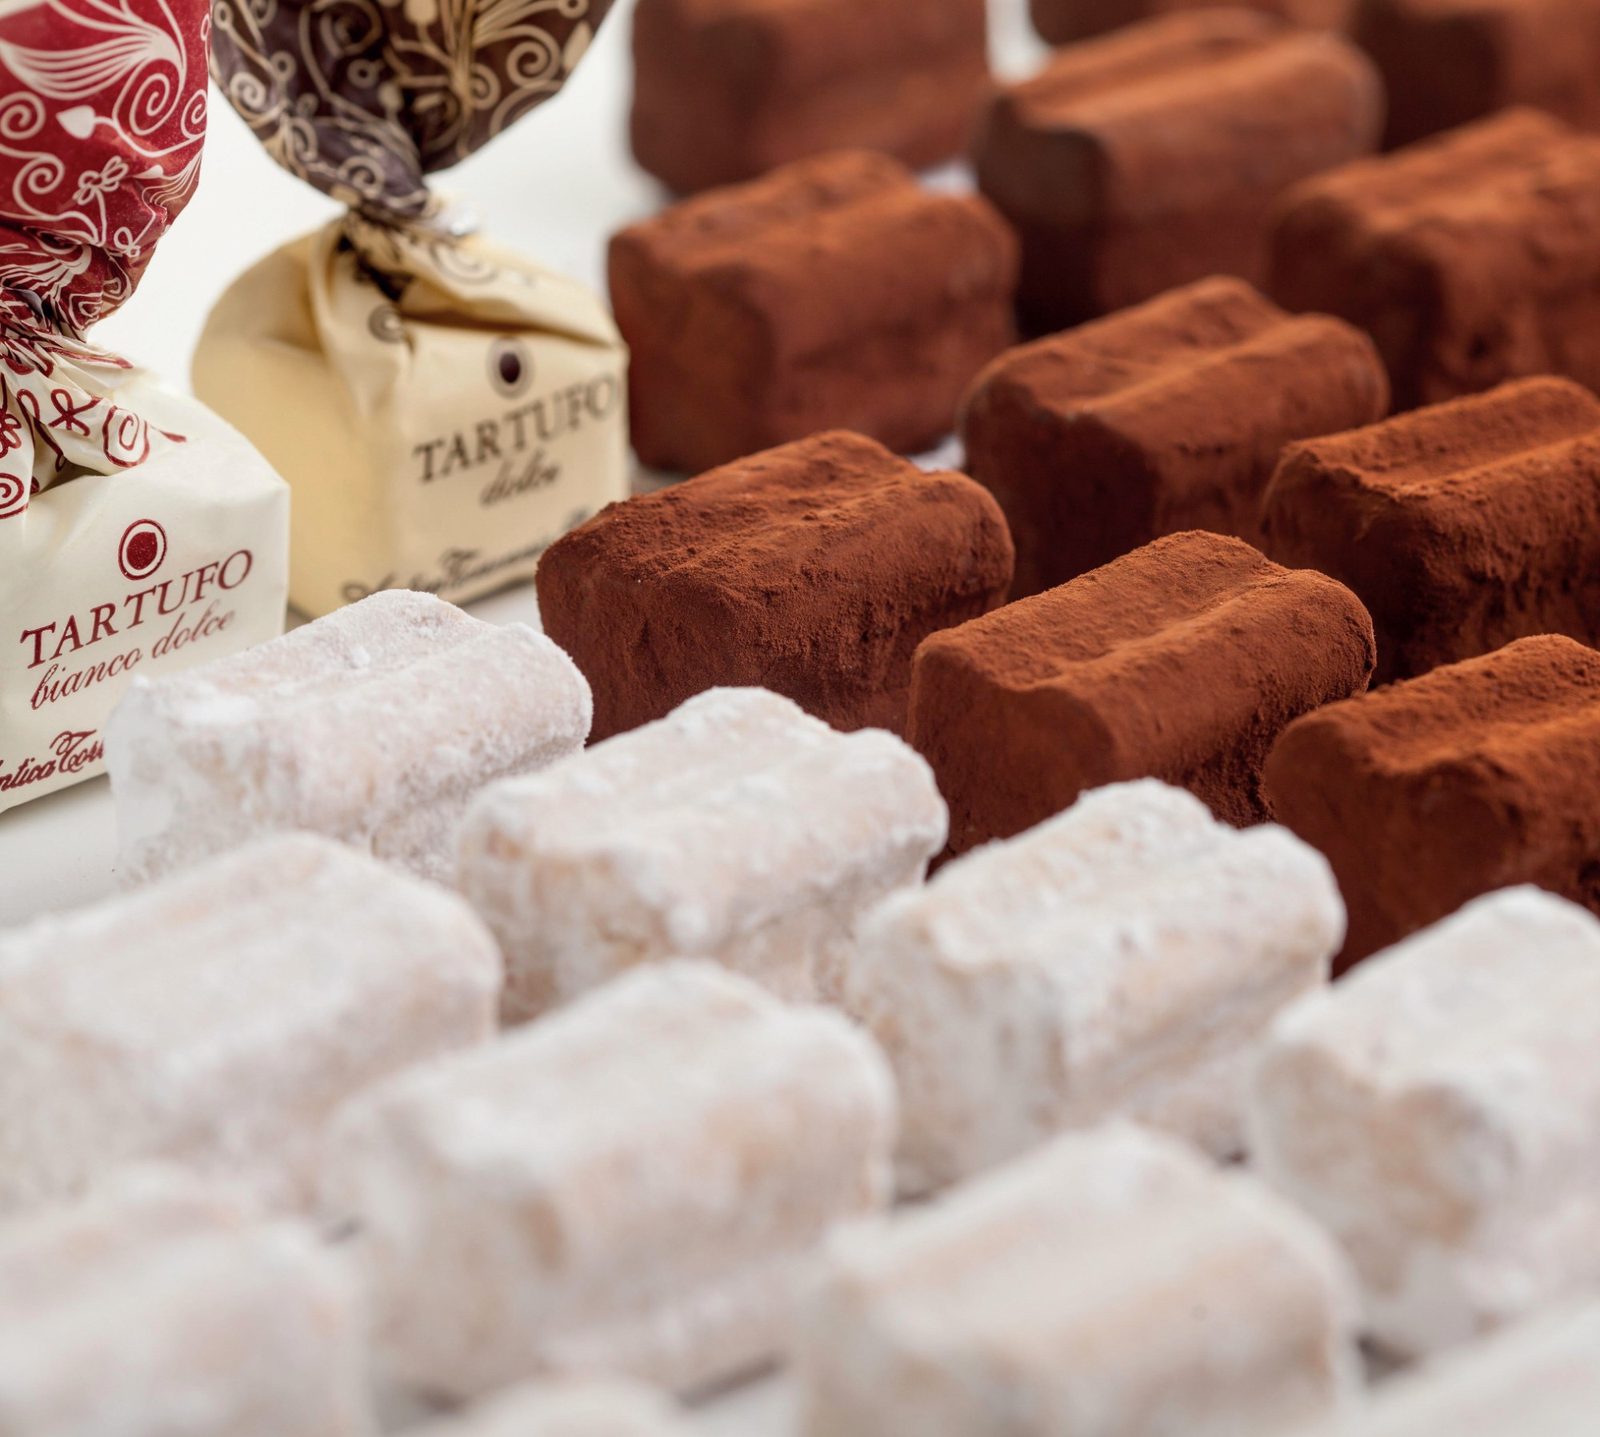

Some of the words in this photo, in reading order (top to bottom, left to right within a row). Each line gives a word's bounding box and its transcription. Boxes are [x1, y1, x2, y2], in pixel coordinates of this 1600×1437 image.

[412, 373, 617, 483] TARTUFO
[20, 549, 253, 669] TARTUFO
[30, 663, 142, 711] bianco
[152, 599, 236, 659] dolce
[0, 757, 56, 791] ntica
